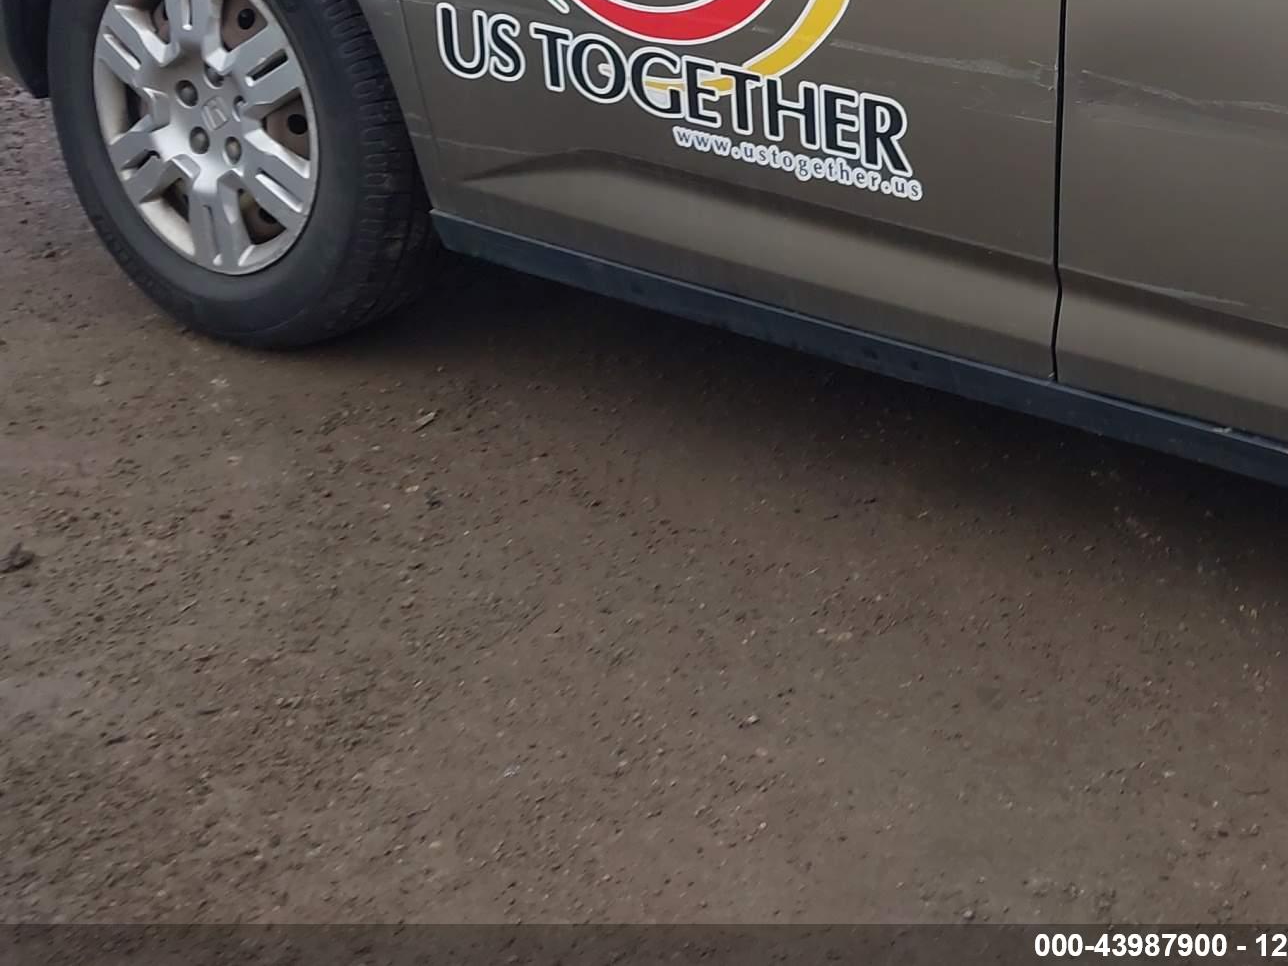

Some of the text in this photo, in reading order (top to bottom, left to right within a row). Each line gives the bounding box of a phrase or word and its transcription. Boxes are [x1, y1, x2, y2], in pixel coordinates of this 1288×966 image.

[436, 2, 913, 177] US TOGETHER
[673, 126, 922, 201] www.ustogether.us
